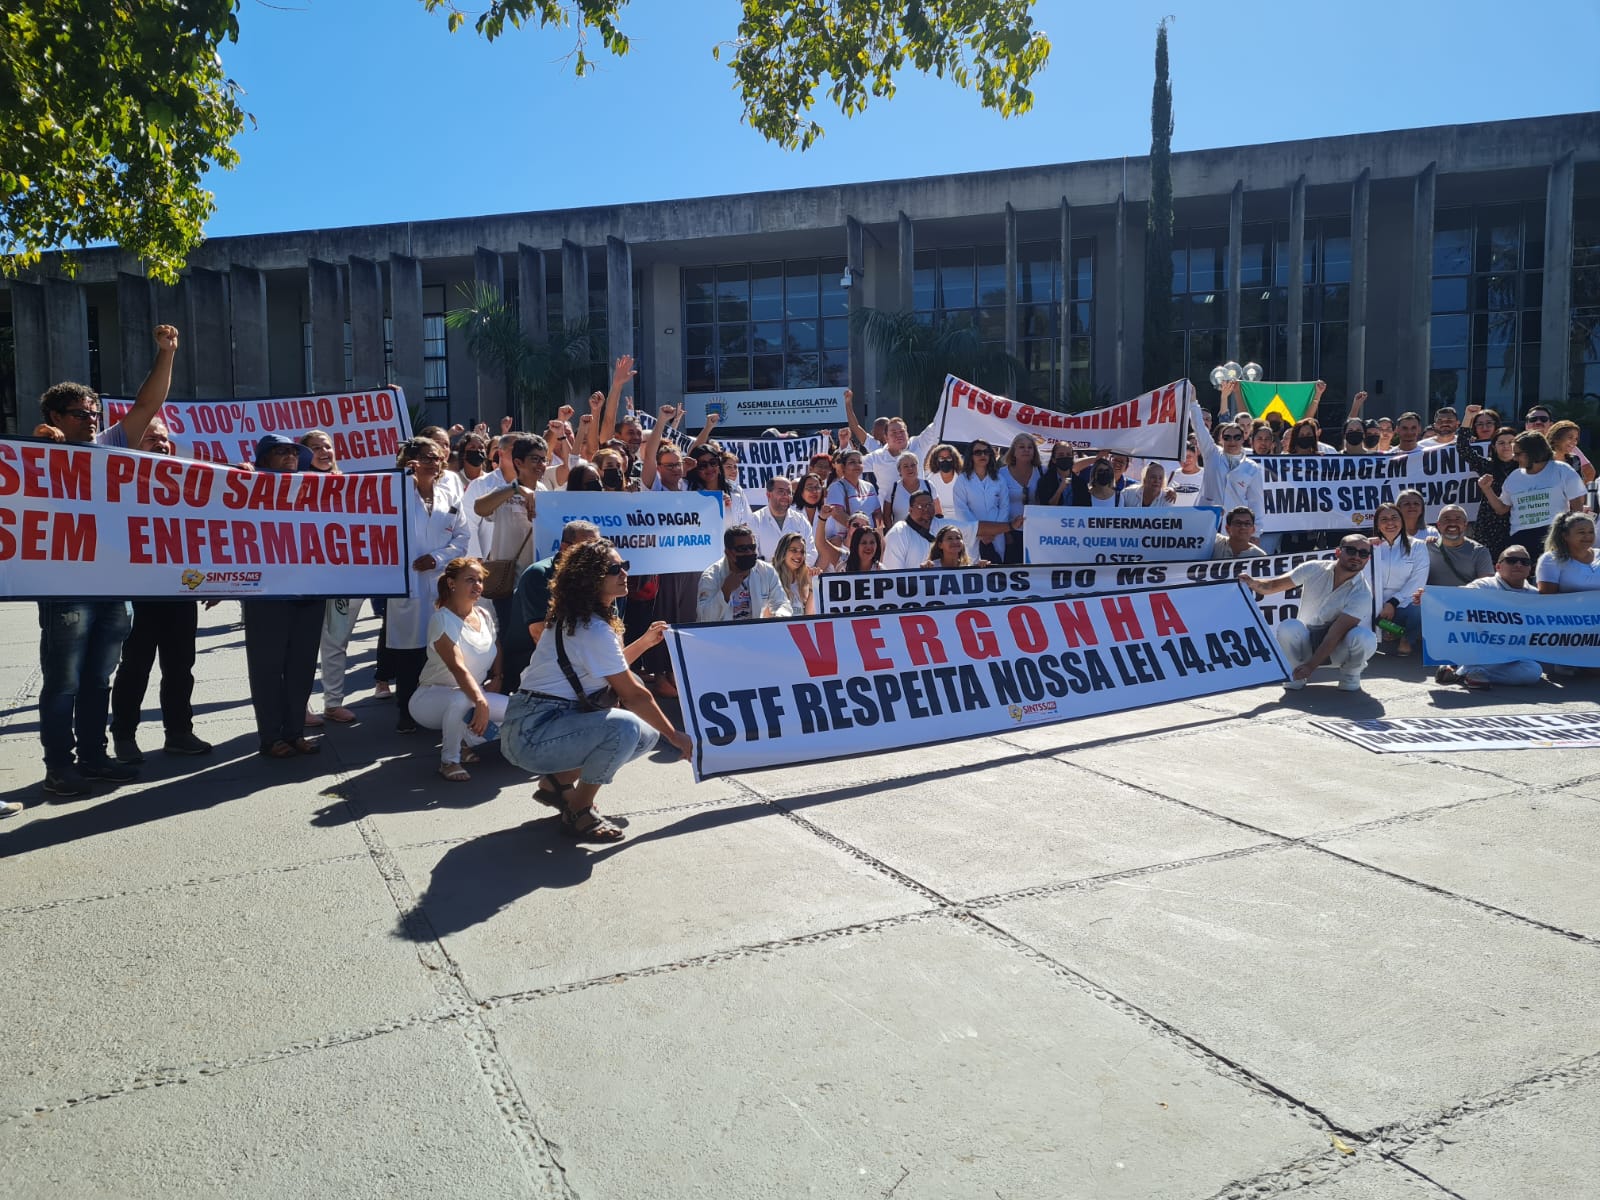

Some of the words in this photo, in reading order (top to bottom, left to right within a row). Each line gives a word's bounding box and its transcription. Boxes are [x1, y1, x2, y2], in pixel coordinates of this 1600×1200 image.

[186, 403, 256, 434] 100%
[257, 398, 335, 432] UNIDO
[337, 393, 394, 425] PELO
[737, 401, 785, 409] ASSEMBLEIA
[787, 398, 838, 407] LEGISLATIVA
[951, 379, 1012, 419] PISO
[1147, 383, 1177, 425] JÁ
[748, 441, 783, 465] RUA
[783, 438, 818, 463] PELO
[0, 444, 92, 501] SEM
[106, 454, 215, 508] PISO
[222, 466, 398, 515] SALARIAL
[1252, 456, 1409, 482] NFERMAGEM
[1263, 487, 1334, 514] AMAIS
[1337, 479, 1395, 511] SERÁ
[593, 515, 622, 527] PISO
[626, 510, 655, 527] NÃO
[657, 512, 701, 528] PAGAR,
[1060, 518, 1075, 529] SE
[1077, 518, 1086, 529] A
[1087, 517, 1183, 530] ENFERMAGEM
[0, 507, 98, 562] SEM
[127, 516, 400, 566] ENFERMAGEM
[658, 535, 675, 548] VAI
[677, 534, 712, 547] PARAR
[1039, 536, 1080, 549] PARAR,
[1082, 536, 1117, 549] QUEM
[1120, 537, 1139, 548] VAI
[1141, 536, 1205, 549] CUIDAR?
[828, 571, 1030, 602] DEPUTADOS
[1051, 568, 1096, 589] DO
[1116, 565, 1168, 586] MS
[1444, 610, 1464, 622] DE
[1466, 609, 1523, 625] HEROIS
[1525, 614, 1545, 626] DA
[787, 592, 1188, 677] VERGONHA
[1447, 632, 1458, 644] A
[1461, 630, 1505, 645] VILÕES
[1508, 635, 1526, 645] DA
[699, 686, 784, 746] STF
[791, 664, 991, 735] RESPEITA
[988, 648, 1116, 705] NOSSA
[1110, 641, 1166, 687] LEI
[1161, 626, 1272, 677] 14.434
